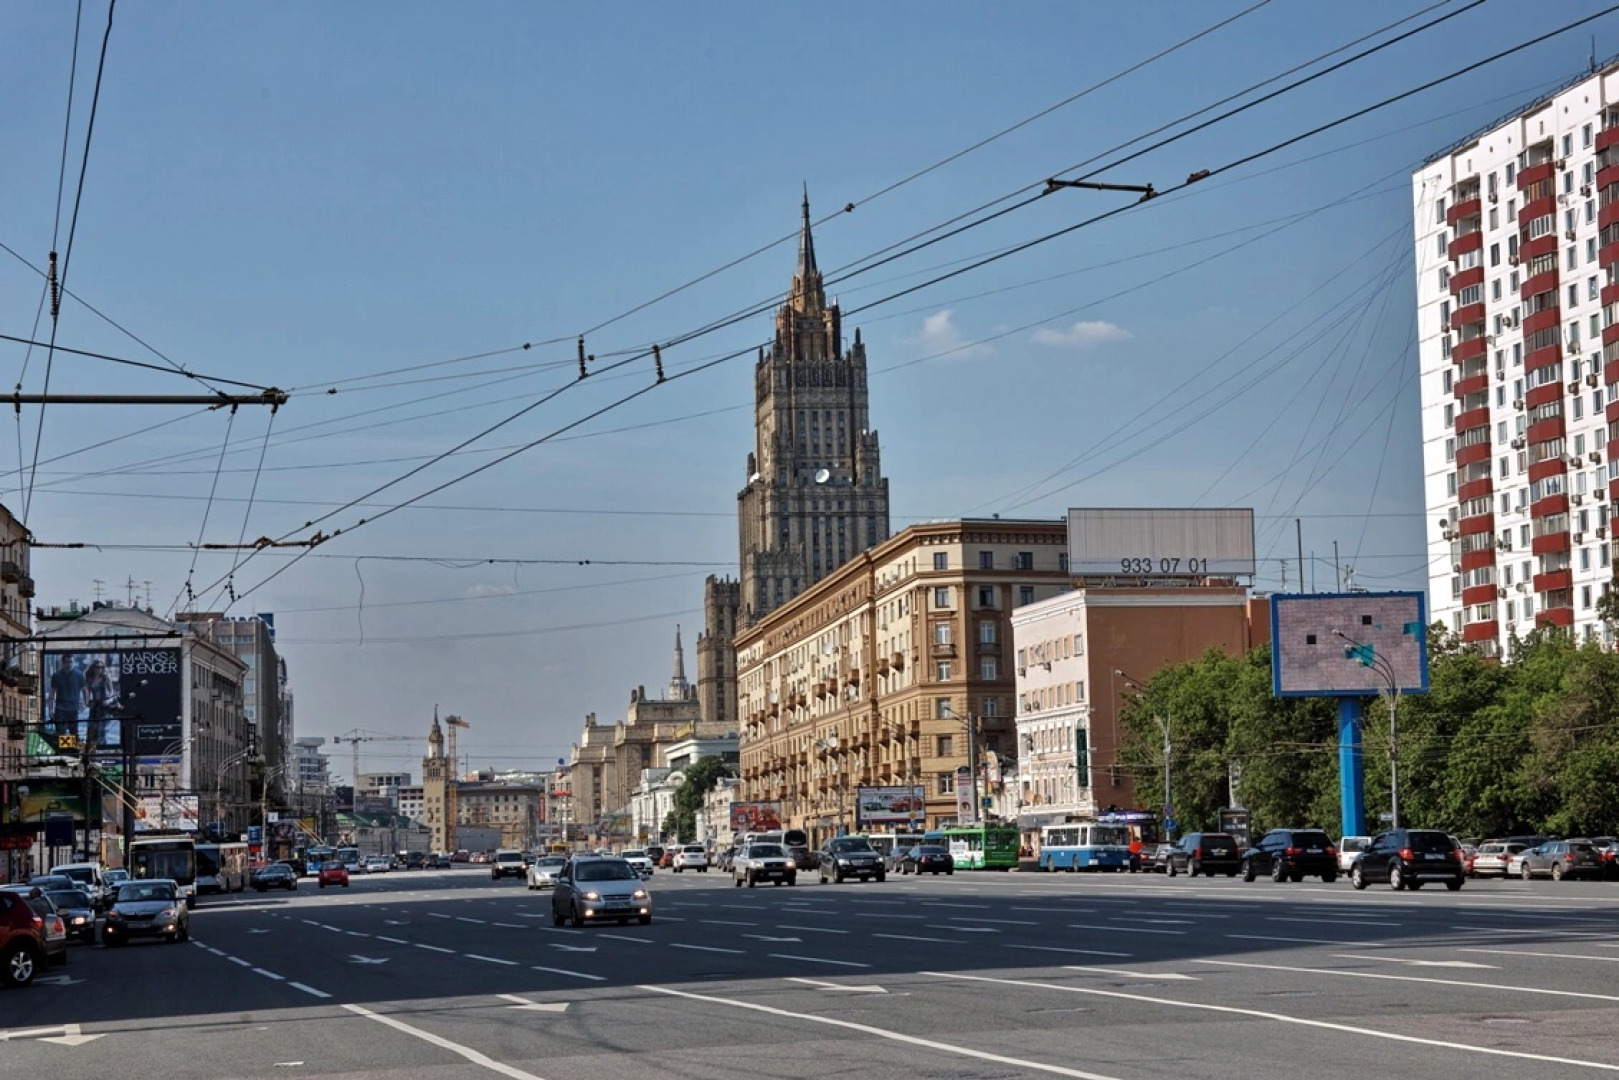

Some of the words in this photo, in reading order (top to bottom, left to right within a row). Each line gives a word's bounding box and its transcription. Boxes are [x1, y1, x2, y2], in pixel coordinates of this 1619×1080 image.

[1121, 557, 1152, 573] 933
[1160, 557, 1180, 573] 07
[1188, 557, 1207, 573] 01
[122, 663, 177, 675] SPENCER
